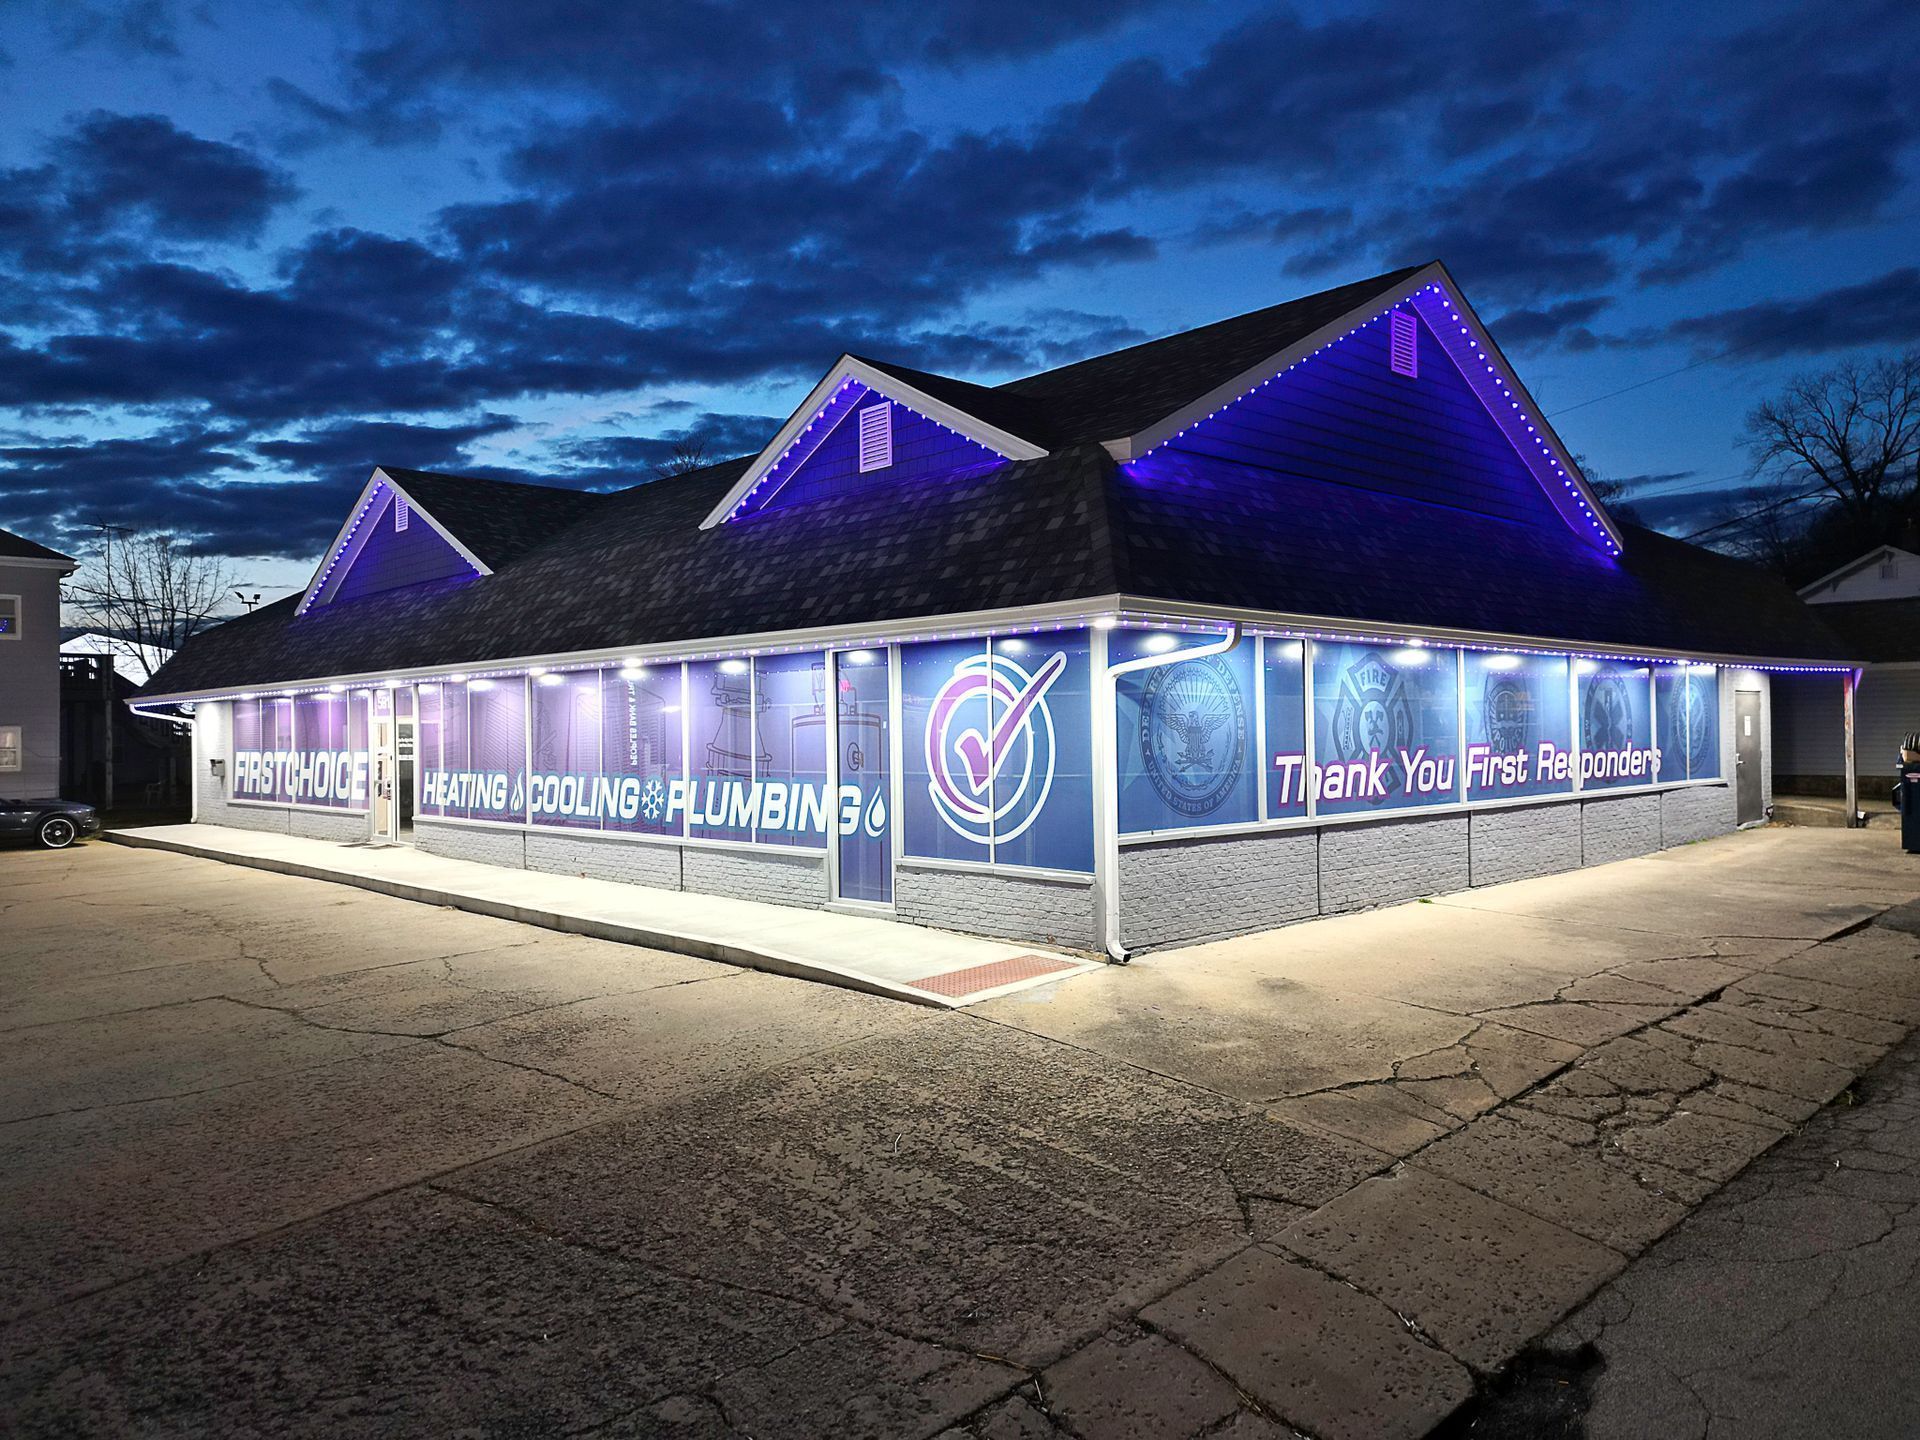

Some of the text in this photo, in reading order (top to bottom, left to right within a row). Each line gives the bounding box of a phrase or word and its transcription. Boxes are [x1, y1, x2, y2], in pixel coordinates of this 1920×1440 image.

[1360, 669, 1387, 687] FIRE
[234, 751, 369, 801] FIRST CHOICE
[1275, 741, 1662, 804] Thank You First Responders
[422, 772, 862, 836] HEATING COOLING PLUMBING
[1173, 797, 1202, 812] STATES
[1203, 799, 1214, 810] OF
